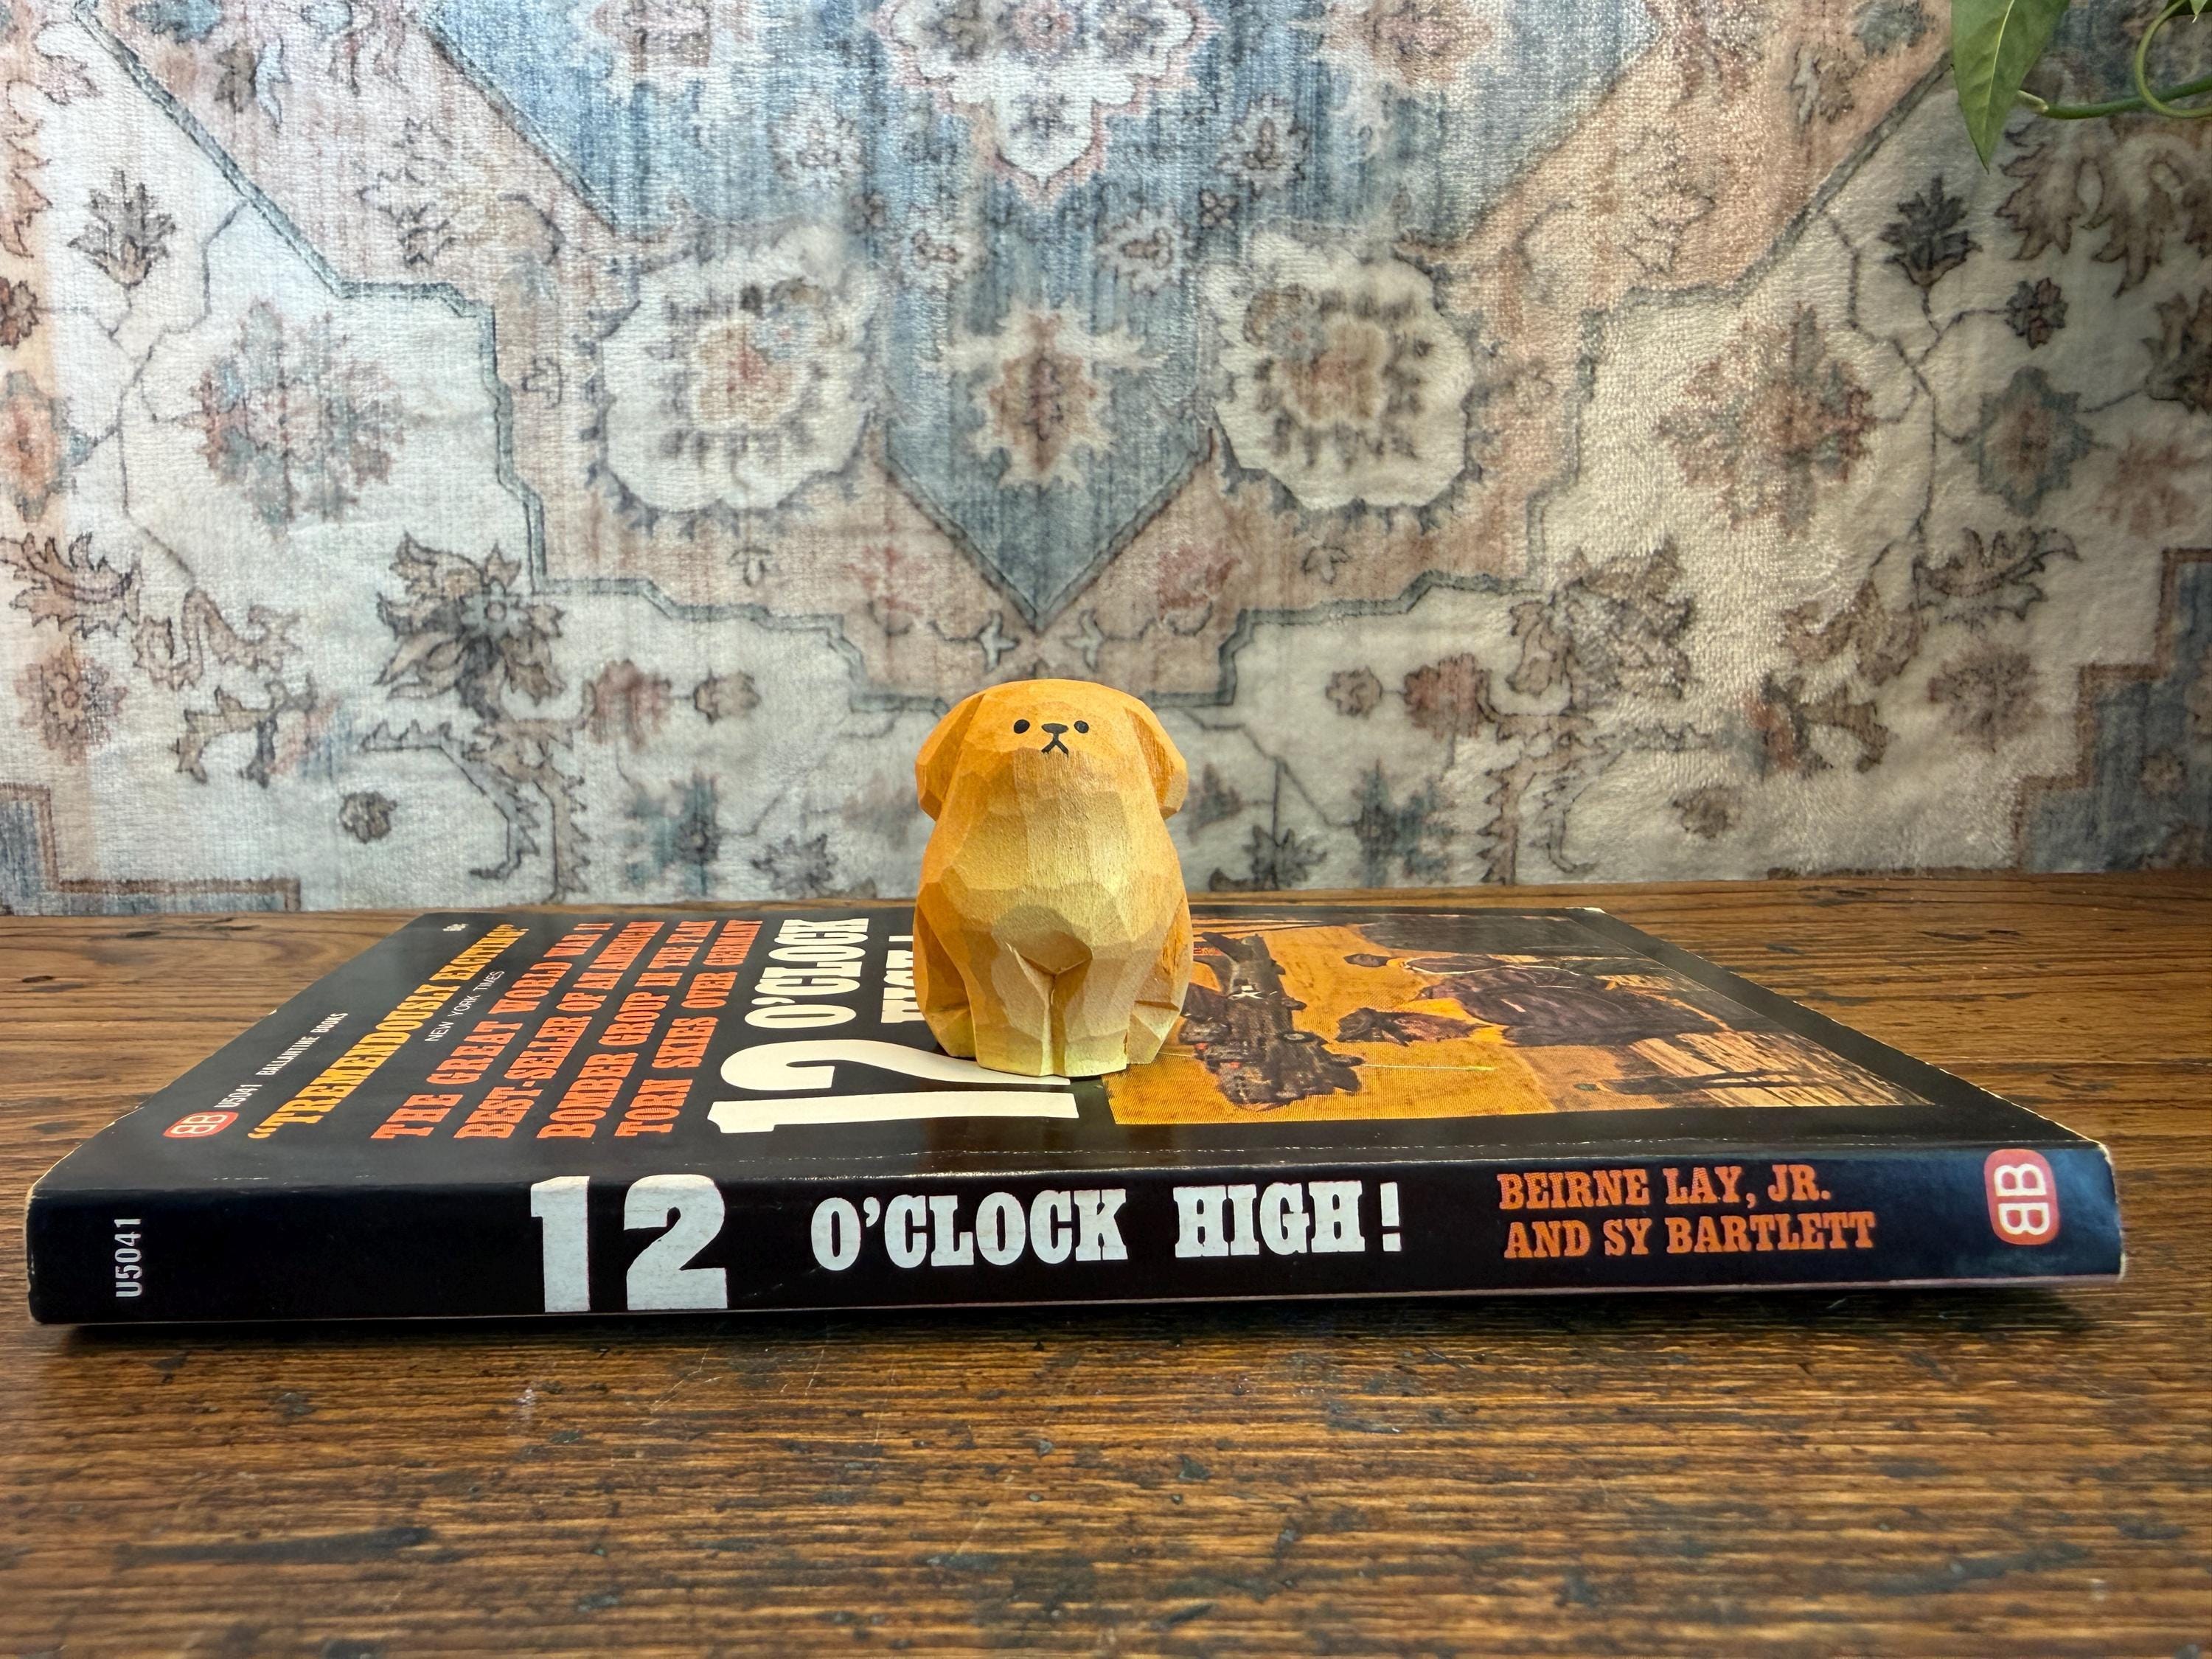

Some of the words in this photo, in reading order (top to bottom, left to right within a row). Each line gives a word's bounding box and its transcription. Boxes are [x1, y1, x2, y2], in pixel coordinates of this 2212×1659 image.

[588, 921, 665, 971] AMERICAN
[647, 946, 700, 969] THE
[665, 920, 717, 944] FLAK
[702, 919, 764, 967] GERMANY
[572, 972, 624, 990] AN
[634, 972, 684, 987] IN
[680, 972, 738, 1009] OVER
[744, 917, 870, 1029] O’CLOCK
[425, 1020, 454, 1042] NEW
[448, 995, 481, 1017] YORK
[473, 970, 505, 992] TIMES
[555, 992, 608, 1012] OF
[597, 992, 670, 1046] GROUP
[247, 984, 461, 1138] “TREMENDOUSLY
[428, 924, 529, 981] EXCITING!”
[370, 1093, 464, 1139] THE
[426, 1020, 524, 1085] GREAT
[488, 961, 573, 1015] WORLD
[543, 933, 603, 958] WAR
[573, 922, 614, 931] II
[651, 1016, 720, 1068] SKIES
[214, 1084, 263, 1108] U5041
[255, 1036, 321, 1076] BALLANTINE
[310, 1012, 349, 1034] BOOKS
[453, 1016, 593, 1138] BEST-SELLER
[707, 1039, 1079, 1134] 12
[536, 1052, 639, 1138] BOMBER
[613, 1079, 694, 1137] TORN
[1496, 1168, 1651, 1210] BEIRNE
[1662, 1165, 1757, 1209] LAY,
[1767, 1164, 1832, 1203] JR.
[114, 1218, 142, 1298] U5041
[529, 1173, 728, 1313] 12
[810, 1188, 1130, 1272] O’CLOCK
[1503, 1220, 1591, 1259] AND
[1603, 1217, 1653, 1256] SY
[1664, 1210, 1876, 1254] BARTLETT
